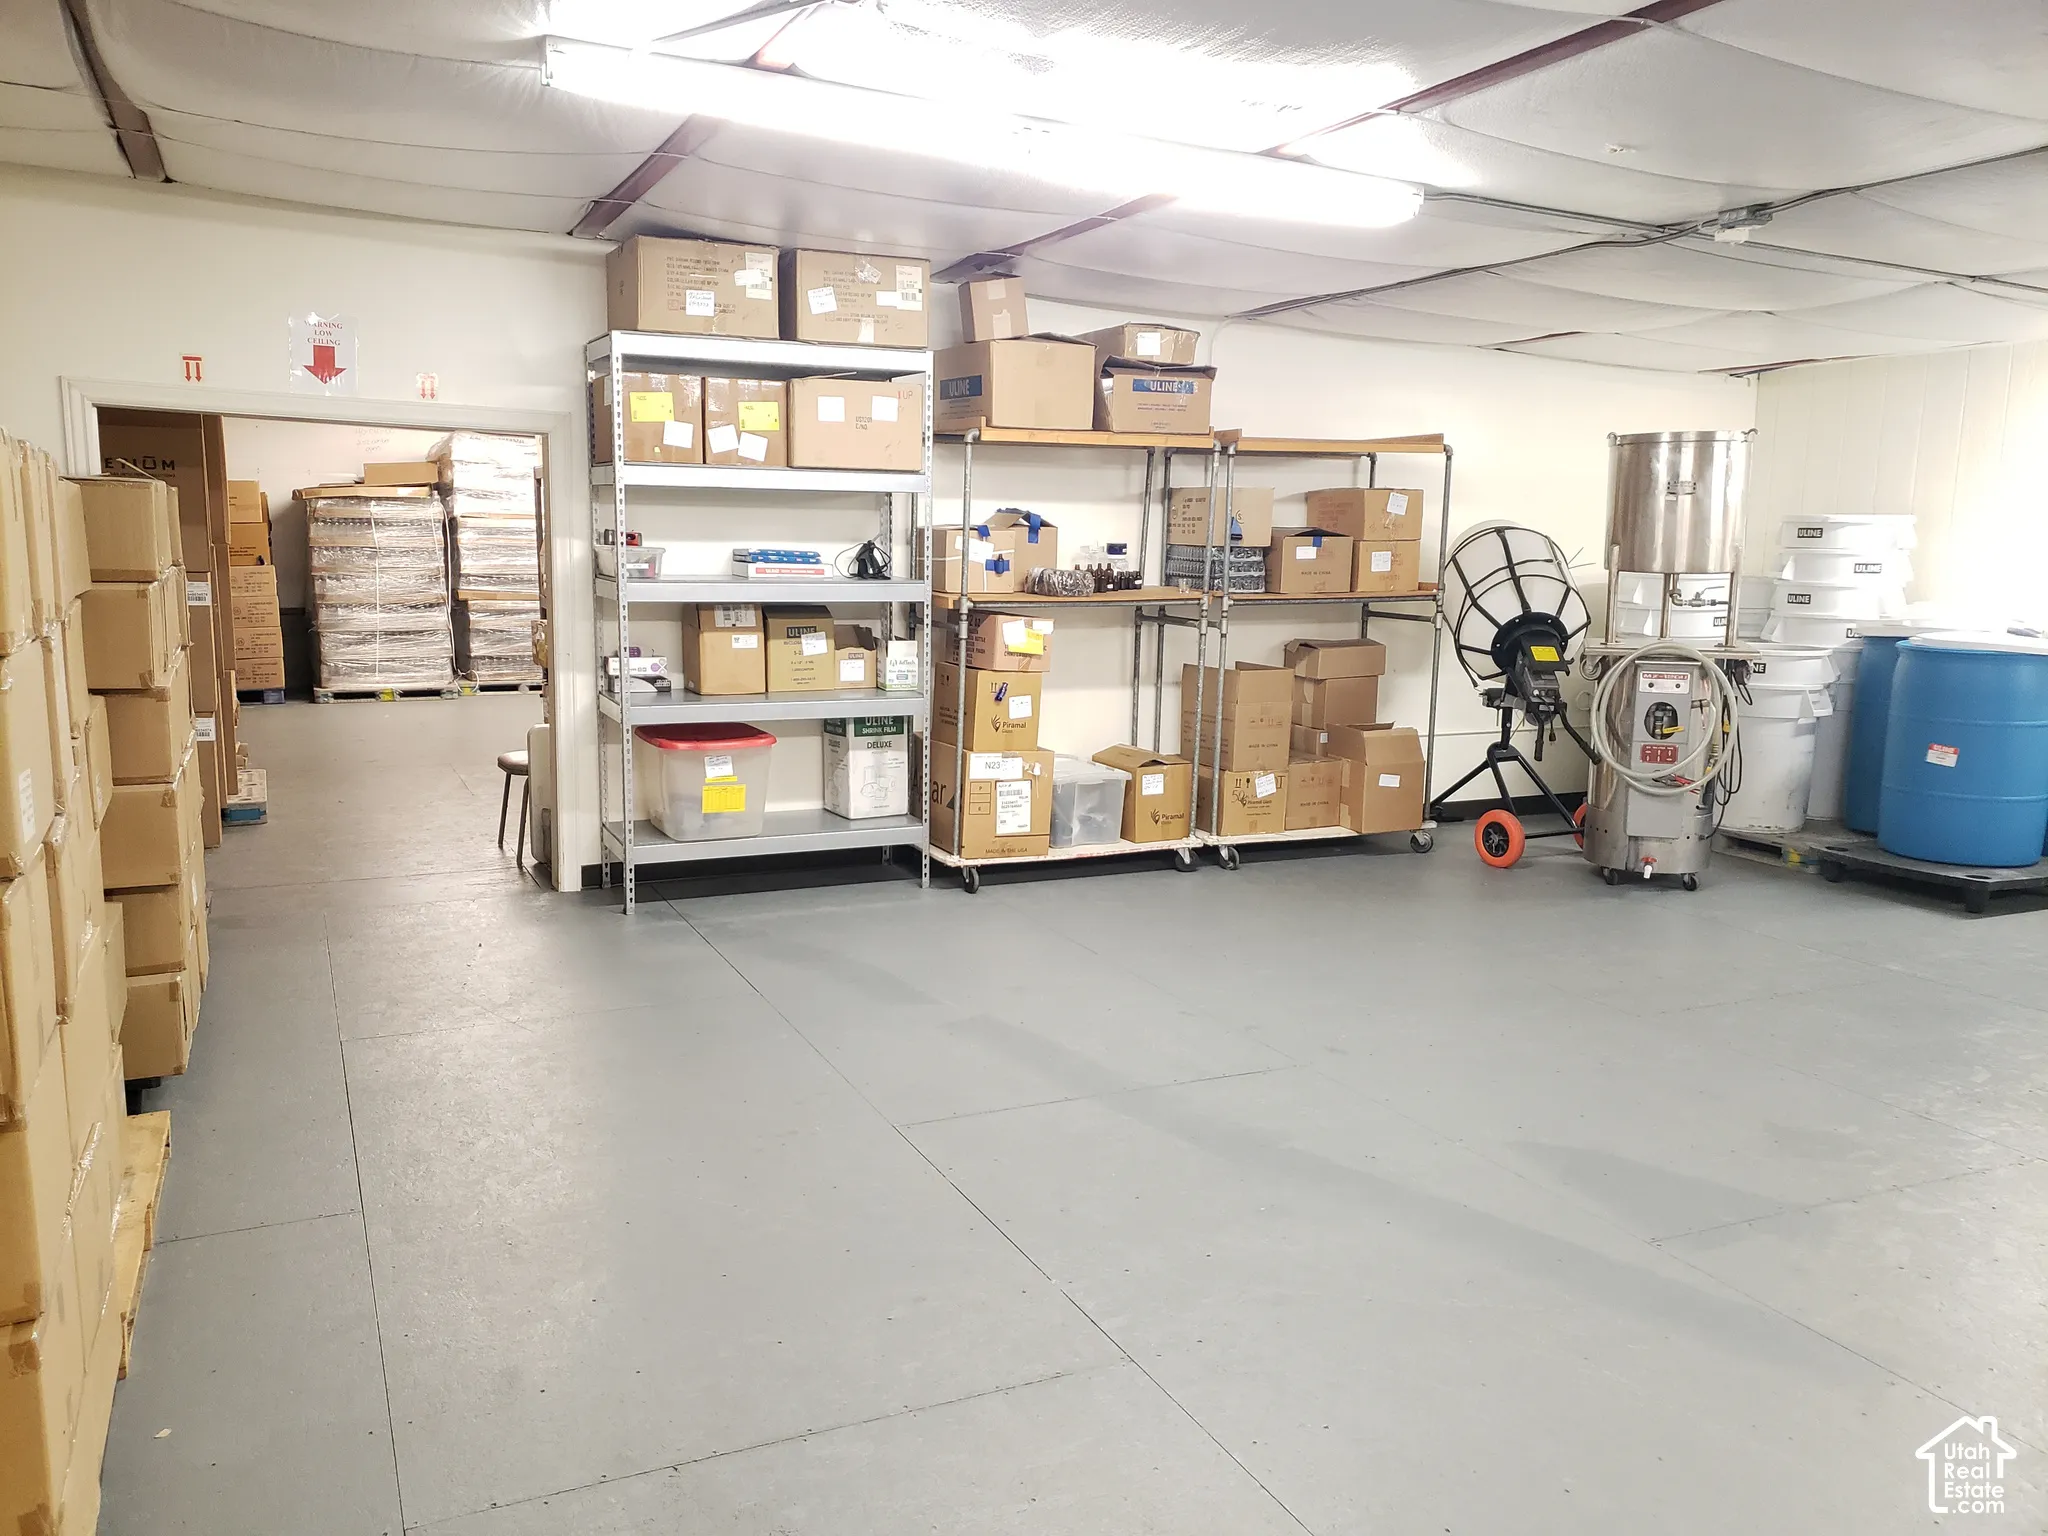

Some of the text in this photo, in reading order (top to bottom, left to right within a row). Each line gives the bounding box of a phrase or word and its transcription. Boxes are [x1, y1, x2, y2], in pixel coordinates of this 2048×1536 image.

[314, 329, 332, 337] LOW
[307, 337, 341, 346] CEILING
[1150, 381, 1178, 392] ULINE
[1798, 528, 1822, 537] ULINE
[1855, 564, 1882, 573] ULINE
[1787, 594, 1810, 603] ULINE
[1002, 721, 1027, 729] Piramal
[862, 726, 883, 734] SHRINK
[866, 740, 893, 749] DELUXE
